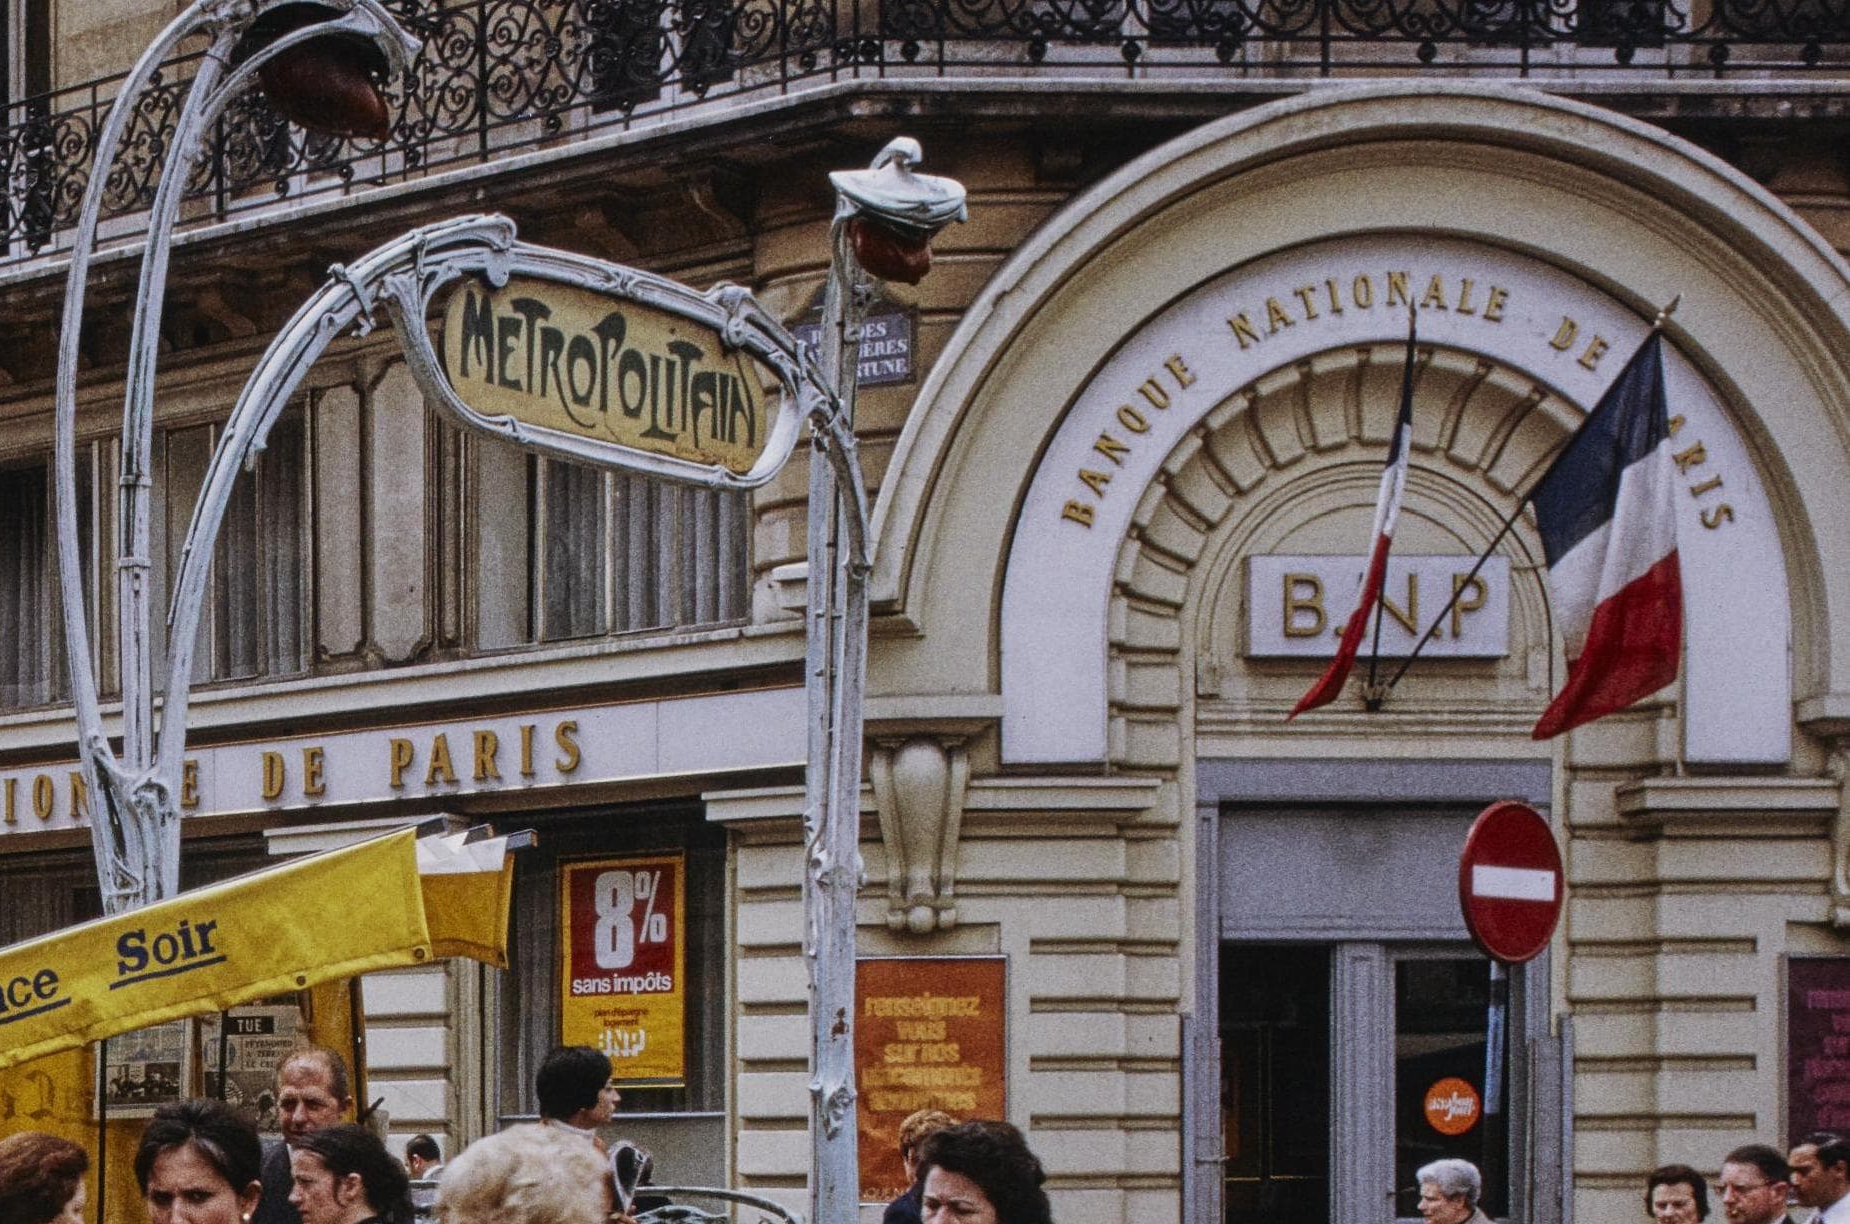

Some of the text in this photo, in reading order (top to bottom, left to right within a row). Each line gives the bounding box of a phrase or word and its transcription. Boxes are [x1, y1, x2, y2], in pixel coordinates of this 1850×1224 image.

[460, 289, 757, 450] METROPOLITAIN
[1061, 270, 1734, 530] BANQUE NATIONALE DE RIS
[262, 746, 327, 800] DE
[389, 720, 583, 788] PARIS
[117, 919, 219, 974] Soir
[595, 870, 667, 969] 8%
[572, 972, 672, 995] sans impôts
